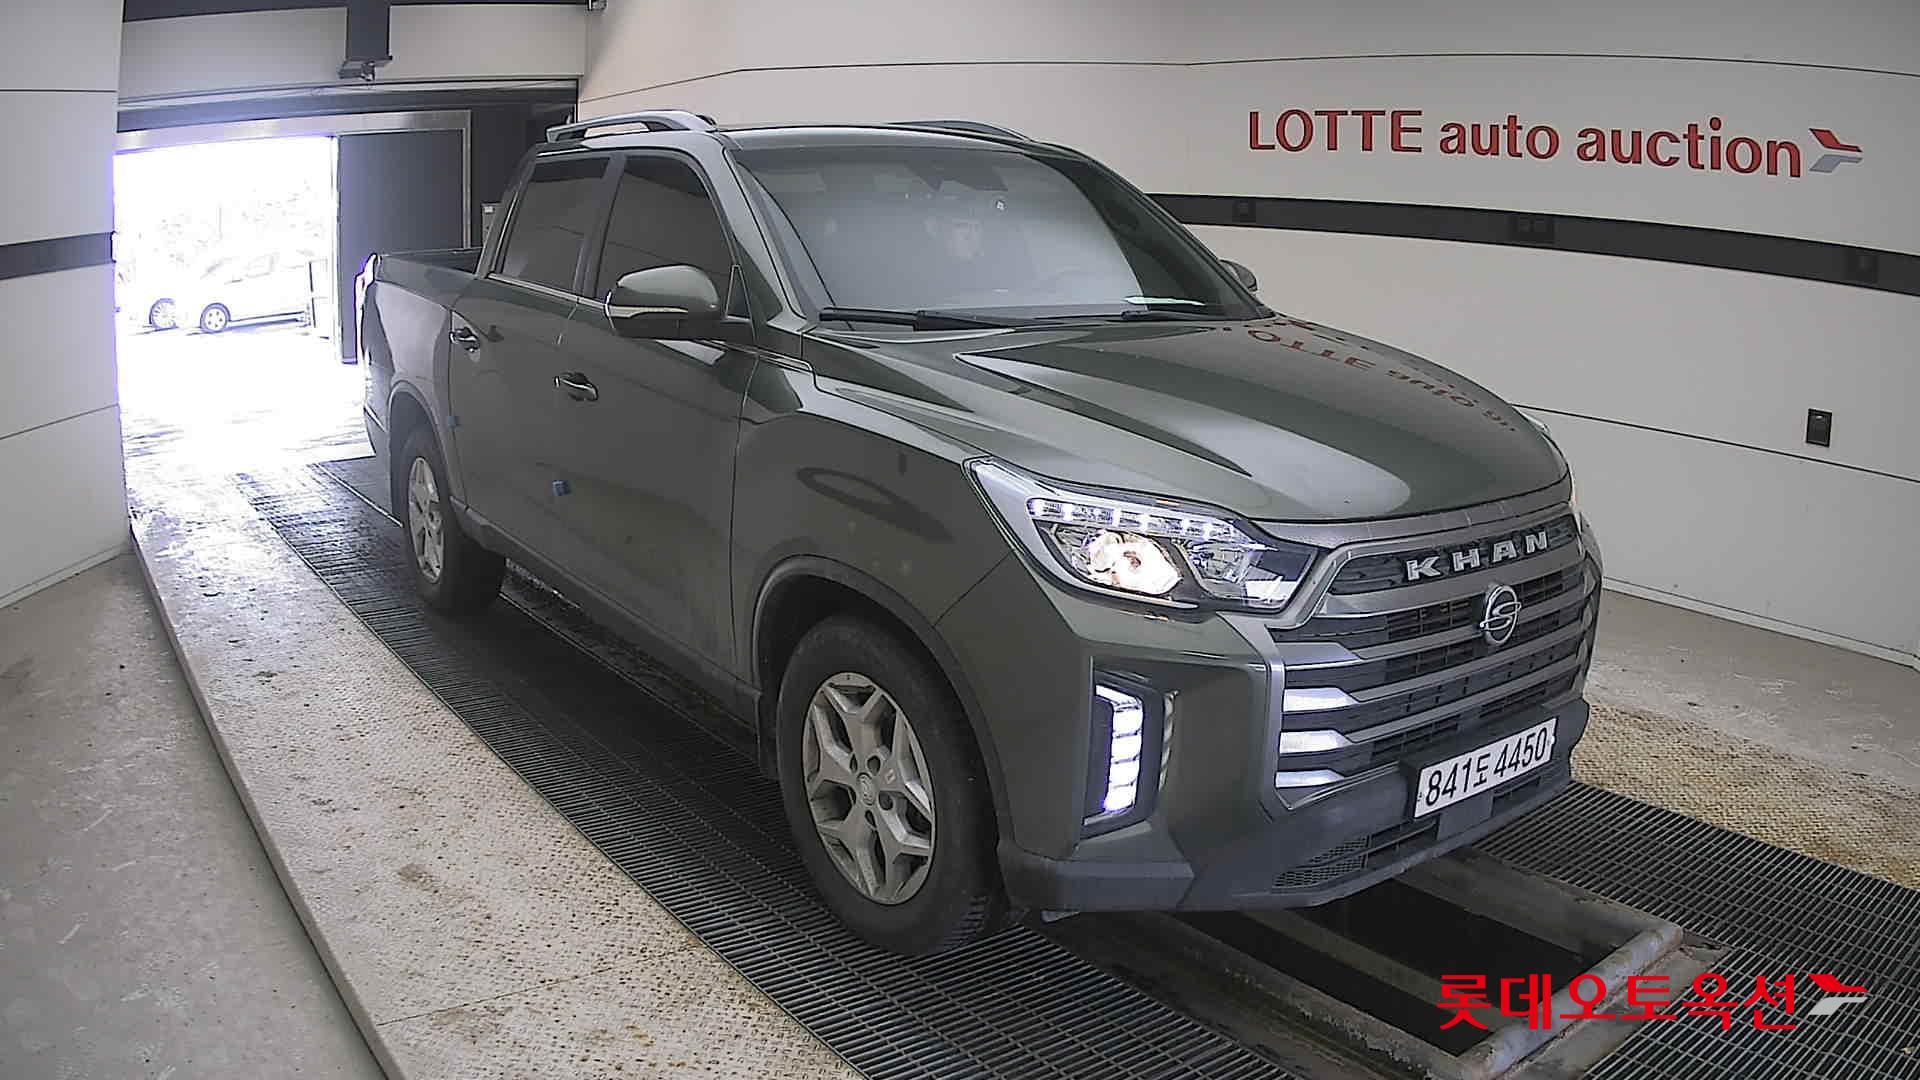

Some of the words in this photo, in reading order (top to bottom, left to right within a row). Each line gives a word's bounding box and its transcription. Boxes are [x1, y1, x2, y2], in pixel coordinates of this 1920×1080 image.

[1248, 110, 1423, 153] LOTTE
[1439, 114, 1560, 159] auto
[1576, 117, 1802, 178] auction
[1406, 531, 1549, 581] KHAN
